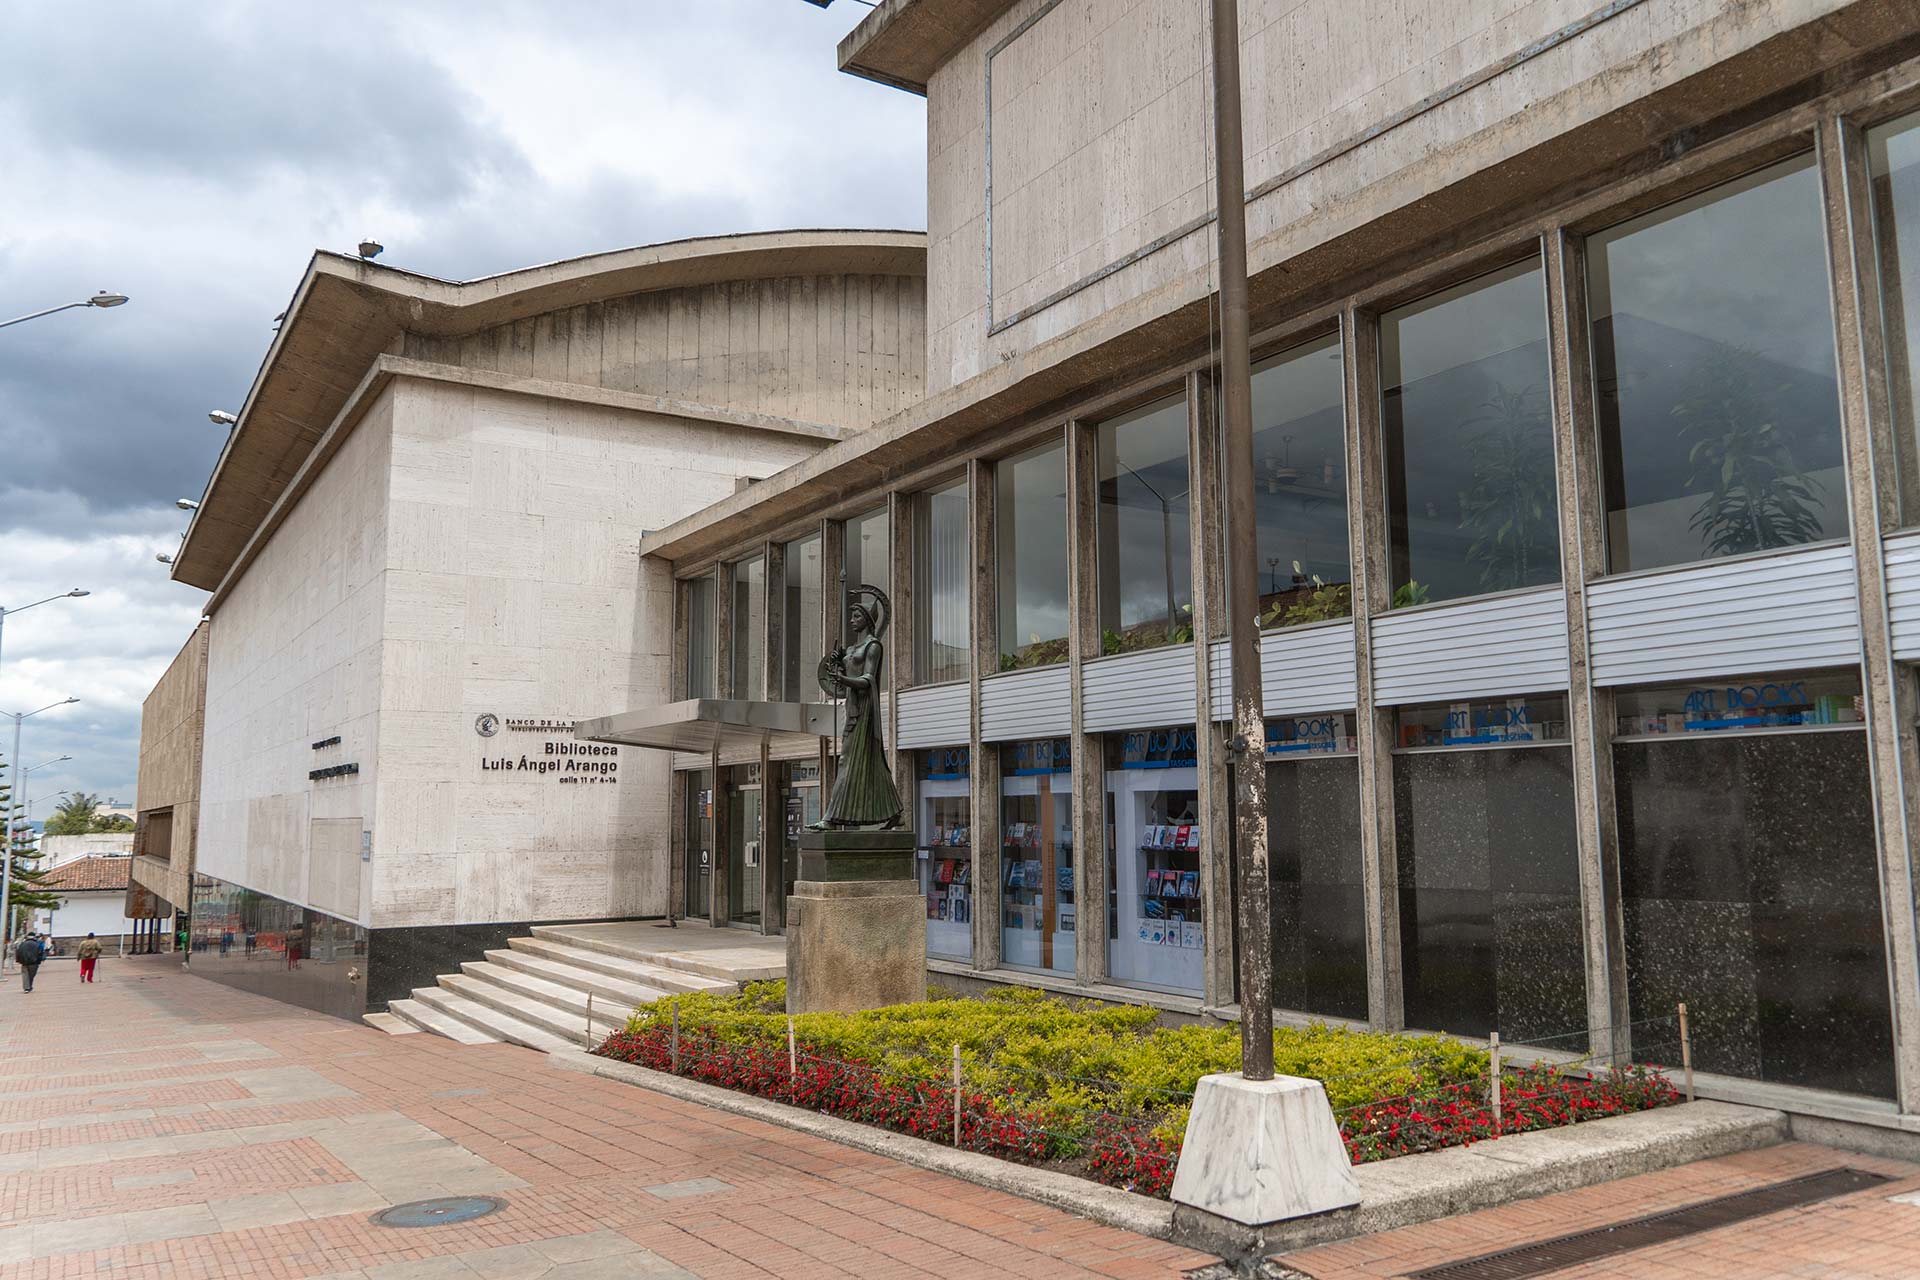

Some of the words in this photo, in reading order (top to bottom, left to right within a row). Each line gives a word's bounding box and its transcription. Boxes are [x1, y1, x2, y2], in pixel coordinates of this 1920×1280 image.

[1684, 689, 1714, 711] ART
[1727, 681, 1807, 710] BOOKS
[505, 718, 535, 726] BANCO
[540, 719, 552, 727] DE
[545, 742, 618, 756] Biblioteca
[482, 757, 513, 770] Luis
[517, 755, 561, 774] Ángel
[565, 759, 617, 775] Arango
[559, 776, 578, 784] calle
[580, 776, 588, 784] 11
